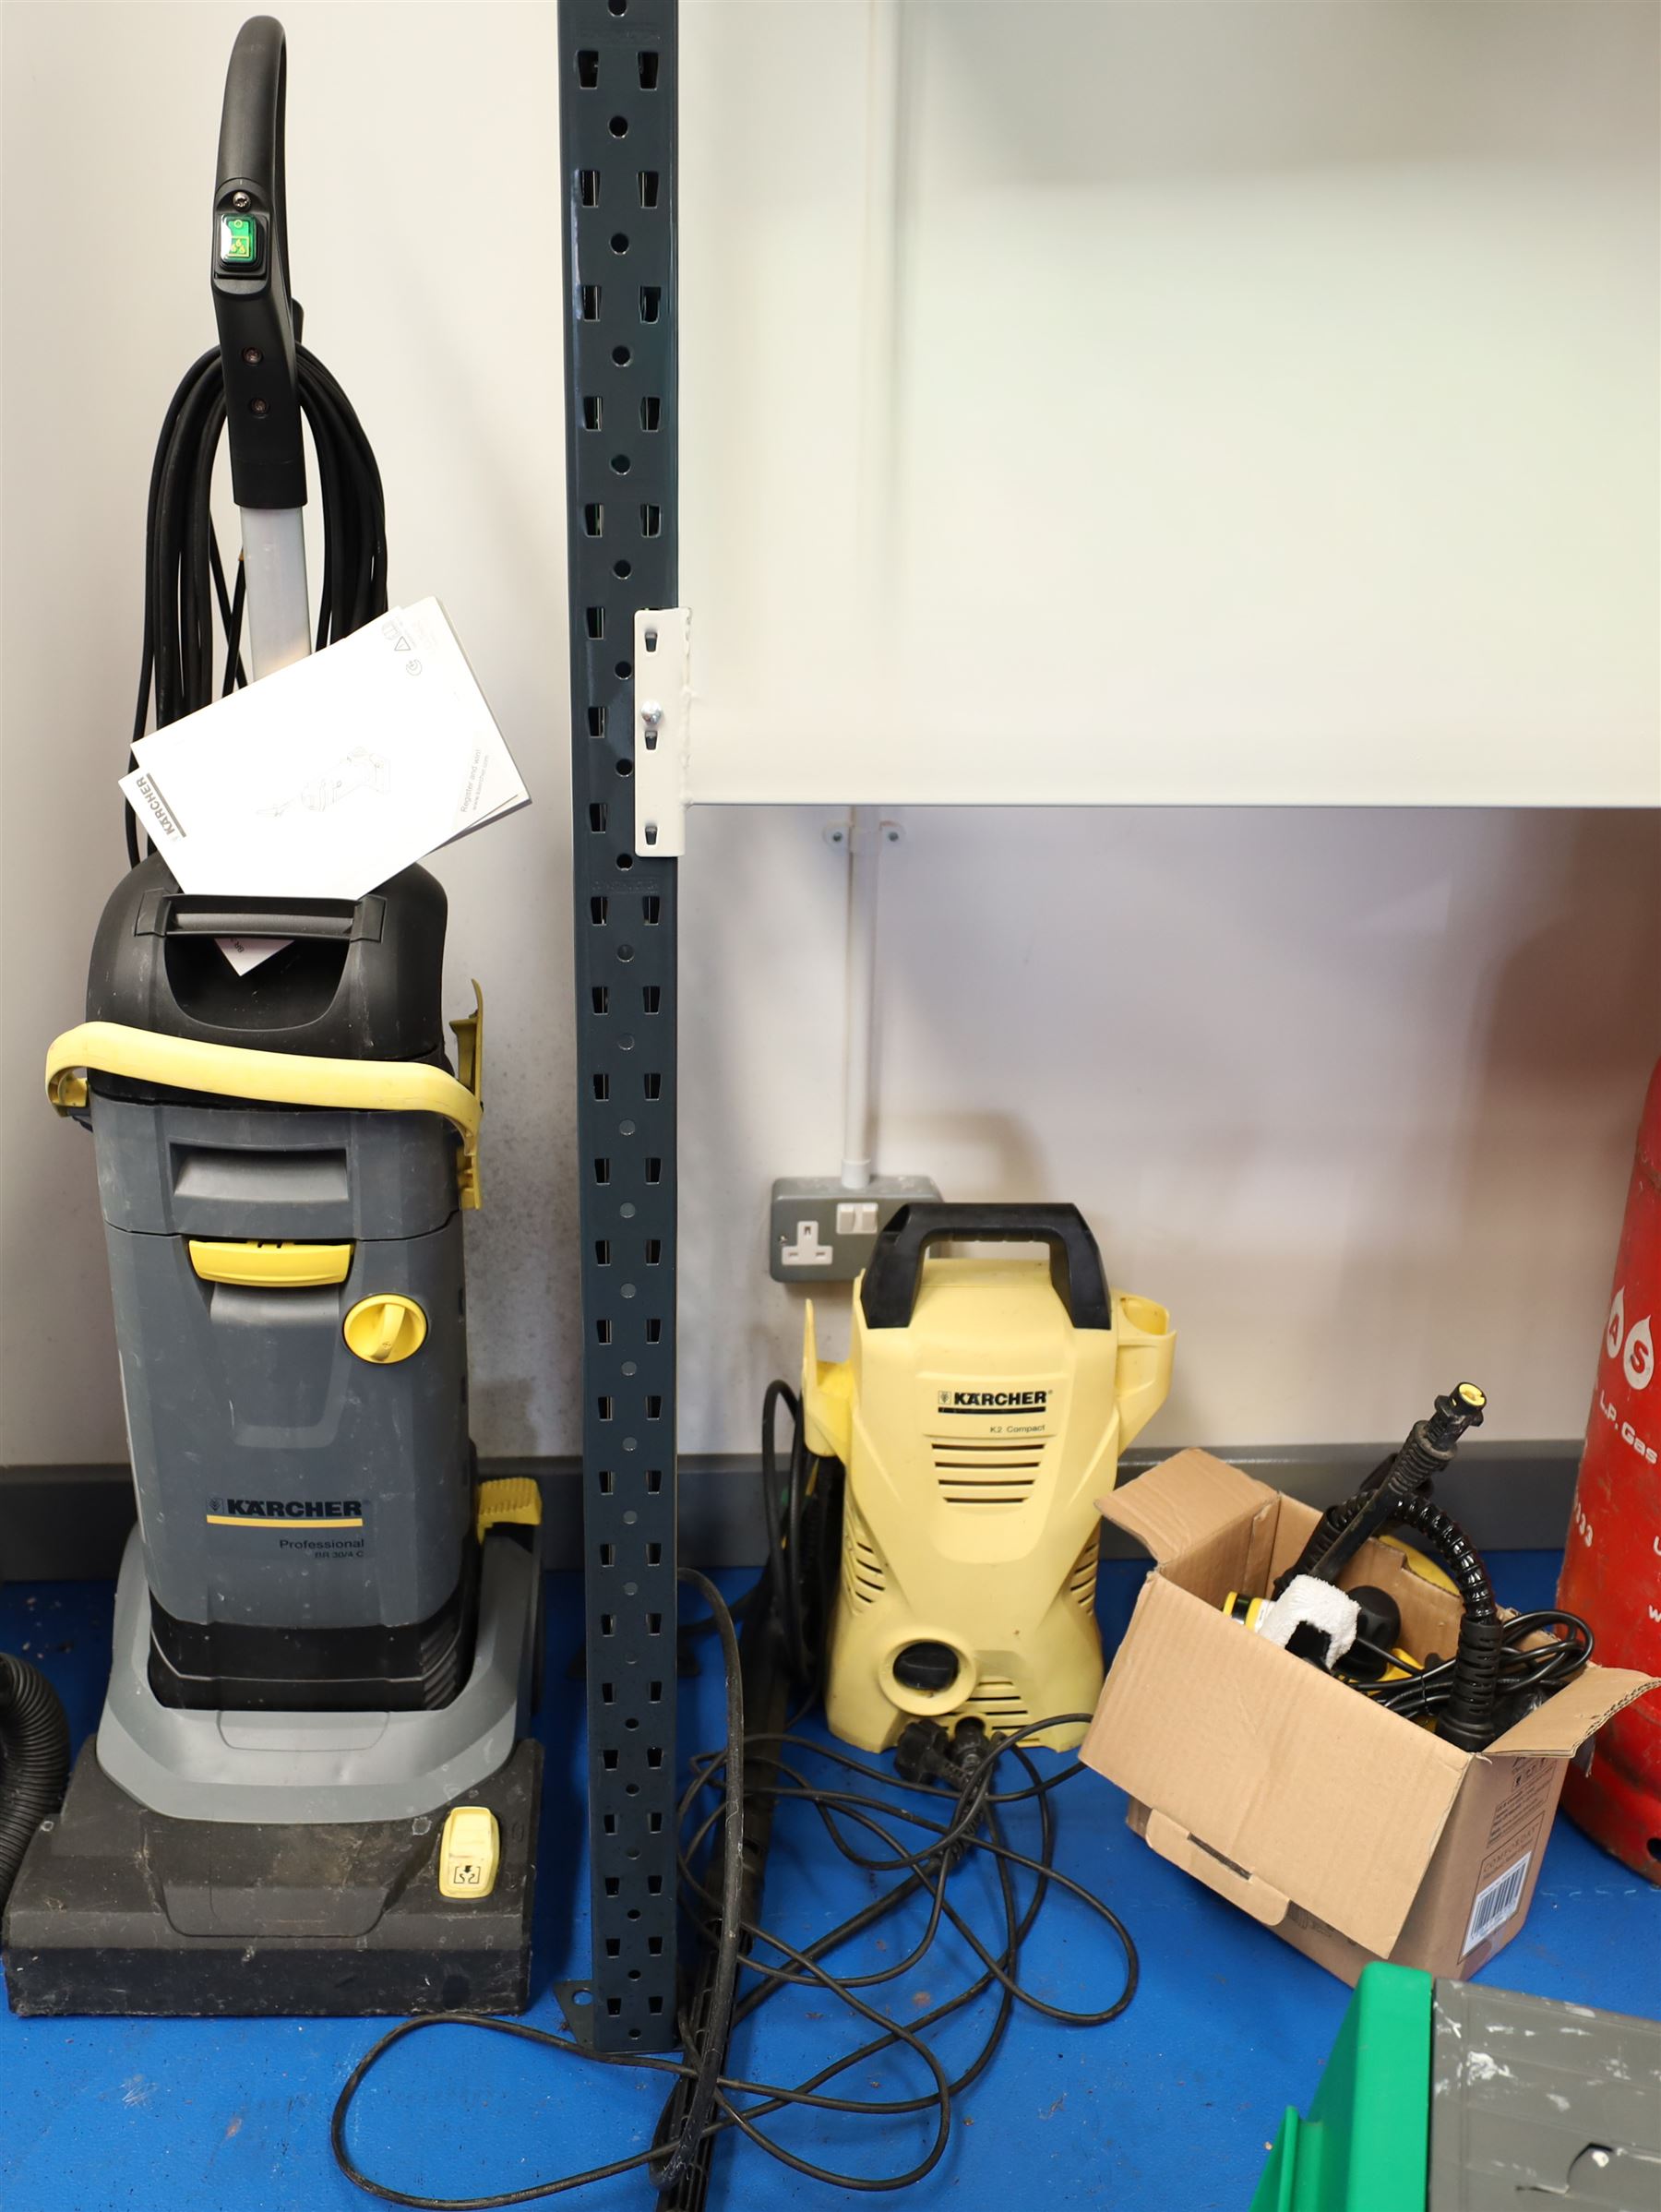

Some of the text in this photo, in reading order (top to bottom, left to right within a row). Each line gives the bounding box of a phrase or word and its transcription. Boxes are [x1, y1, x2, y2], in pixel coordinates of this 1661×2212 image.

[460, 781, 473, 812] Register
[470, 764, 478, 781] and
[953, 1391, 1047, 1406] KÄRCHER
[1006, 1424, 1046, 1434] Compact
[1621, 1421, 1658, 1465] Gas
[227, 1498, 363, 1517] KÄRCHER
[280, 1538, 364, 1549] Professional
